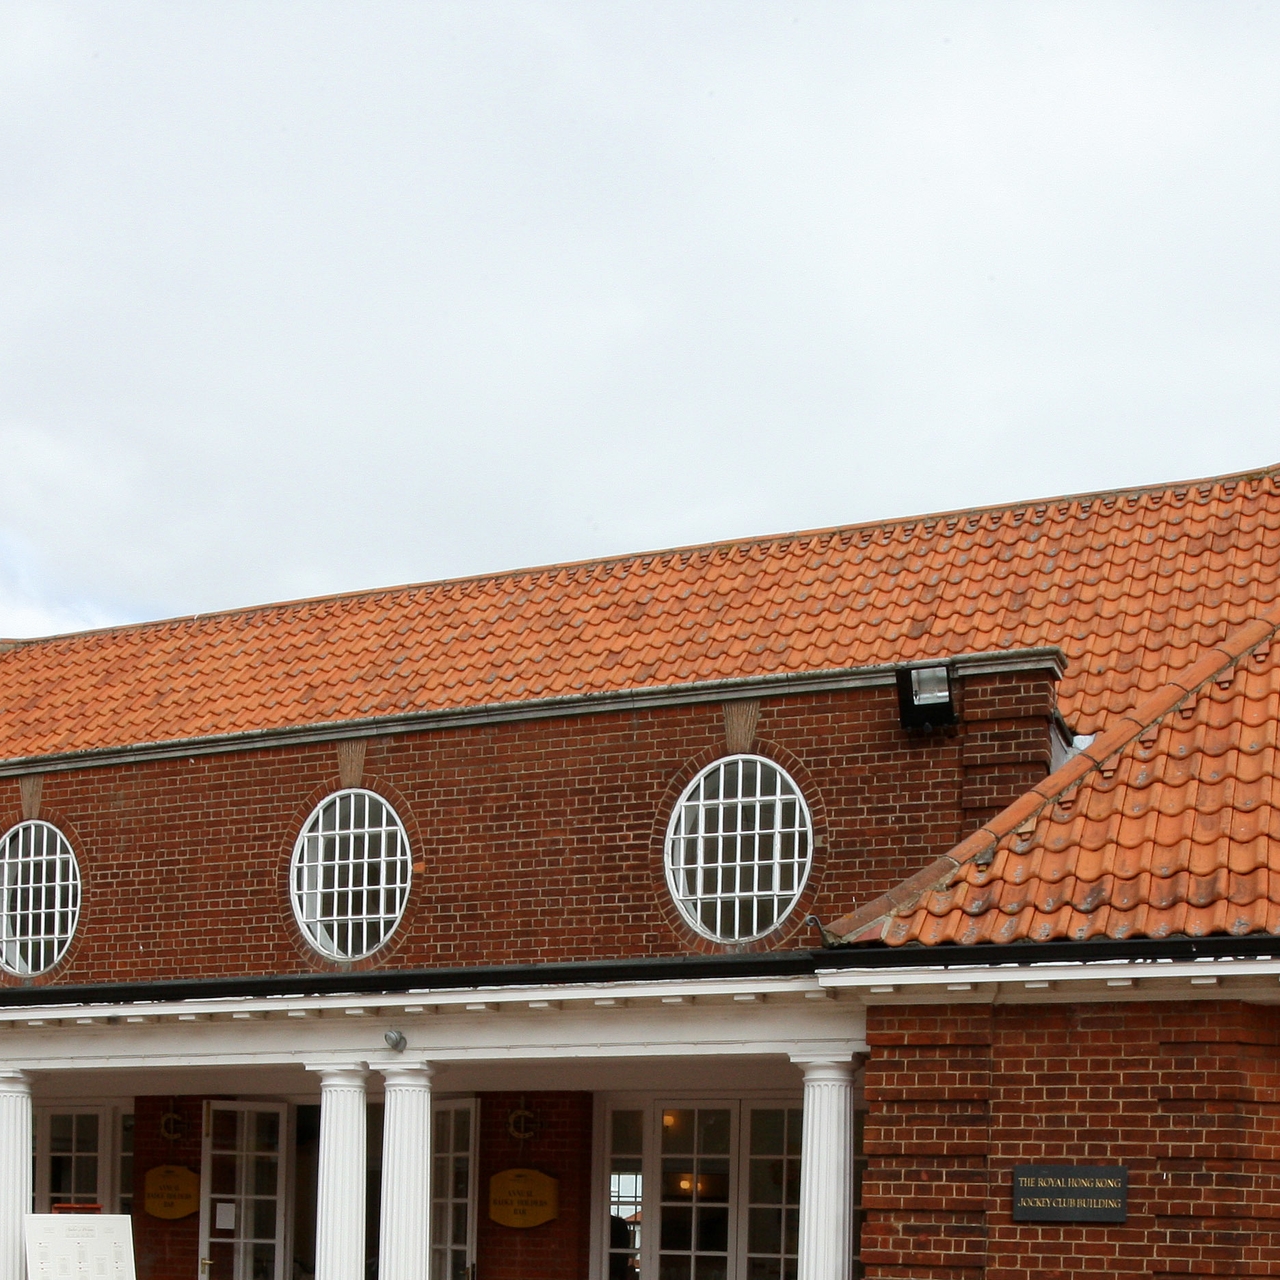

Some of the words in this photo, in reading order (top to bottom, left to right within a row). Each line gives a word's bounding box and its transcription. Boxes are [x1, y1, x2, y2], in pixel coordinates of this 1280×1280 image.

[1018, 1177, 1036, 1187] THE
[1037, 1177, 1066, 1187] ROYAL
[1068, 1178, 1094, 1187] HONG
[1095, 1178, 1121, 1188] KONG
[1018, 1198, 1052, 1207] JOCKEY
[1052, 1198, 1076, 1207] CLUB
[1077, 1198, 1121, 1208] BUILDING
